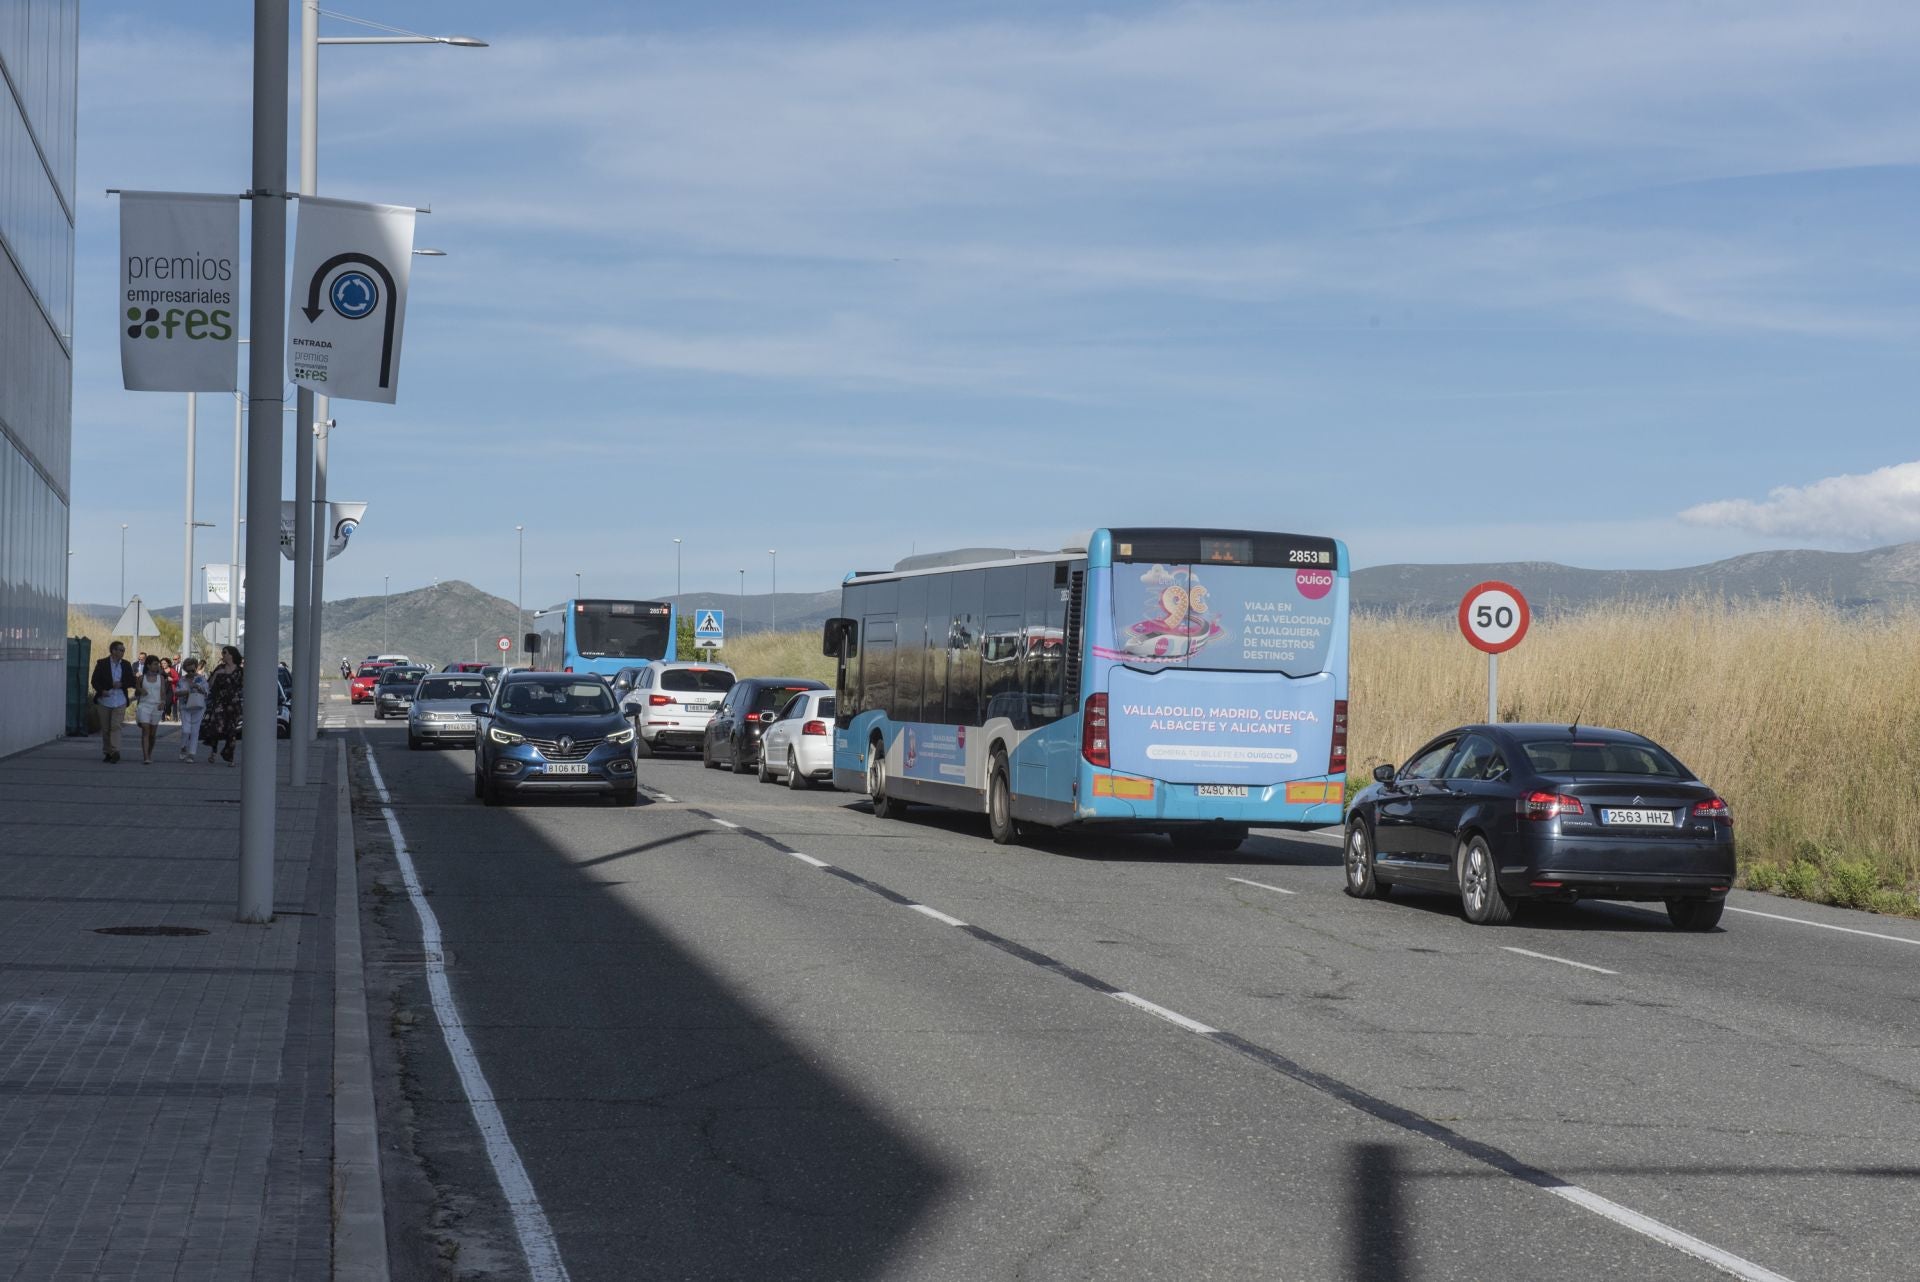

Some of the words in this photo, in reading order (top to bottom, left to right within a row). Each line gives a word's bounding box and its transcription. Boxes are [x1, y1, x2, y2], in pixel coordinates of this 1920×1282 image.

[128, 251, 231, 285] premios
[127, 288, 230, 305] empresariales
[161, 308, 232, 340] fes
[293, 338, 333, 348] ENTRADA
[295, 351, 329, 363] premios
[305, 369, 328, 382] fes
[1289, 550, 1318, 563] 2853
[1244, 601, 1275, 611] VIAJA
[1277, 602, 1292, 611] EN
[1244, 614, 1270, 623] ALTA
[1272, 615, 1332, 625] VELOCIDAD
[1476, 605, 1513, 628] 50
[1243, 625, 1252, 634] A
[1254, 626, 1321, 637] CUALQUIERA
[1243, 638, 1258, 647] DE
[1260, 638, 1315, 649] NUESTROS
[1243, 650, 1295, 661] DESTINOS
[1122, 705, 1206, 719] VALLADOLID,
[1208, 708, 1261, 720] MADRID,
[1264, 709, 1319, 722] CUENCA,
[1150, 720, 1216, 732] ALBACETE
[1219, 722, 1228, 731] Y
[1230, 722, 1292, 734] ALICANTE
[548, 764, 569, 773] 8106
[1200, 784, 1225, 796] 3490
[1227, 785, 1247, 796] KTL
[1610, 811, 1642, 823] 2563
[1646, 812, 1671, 824] HHZ
